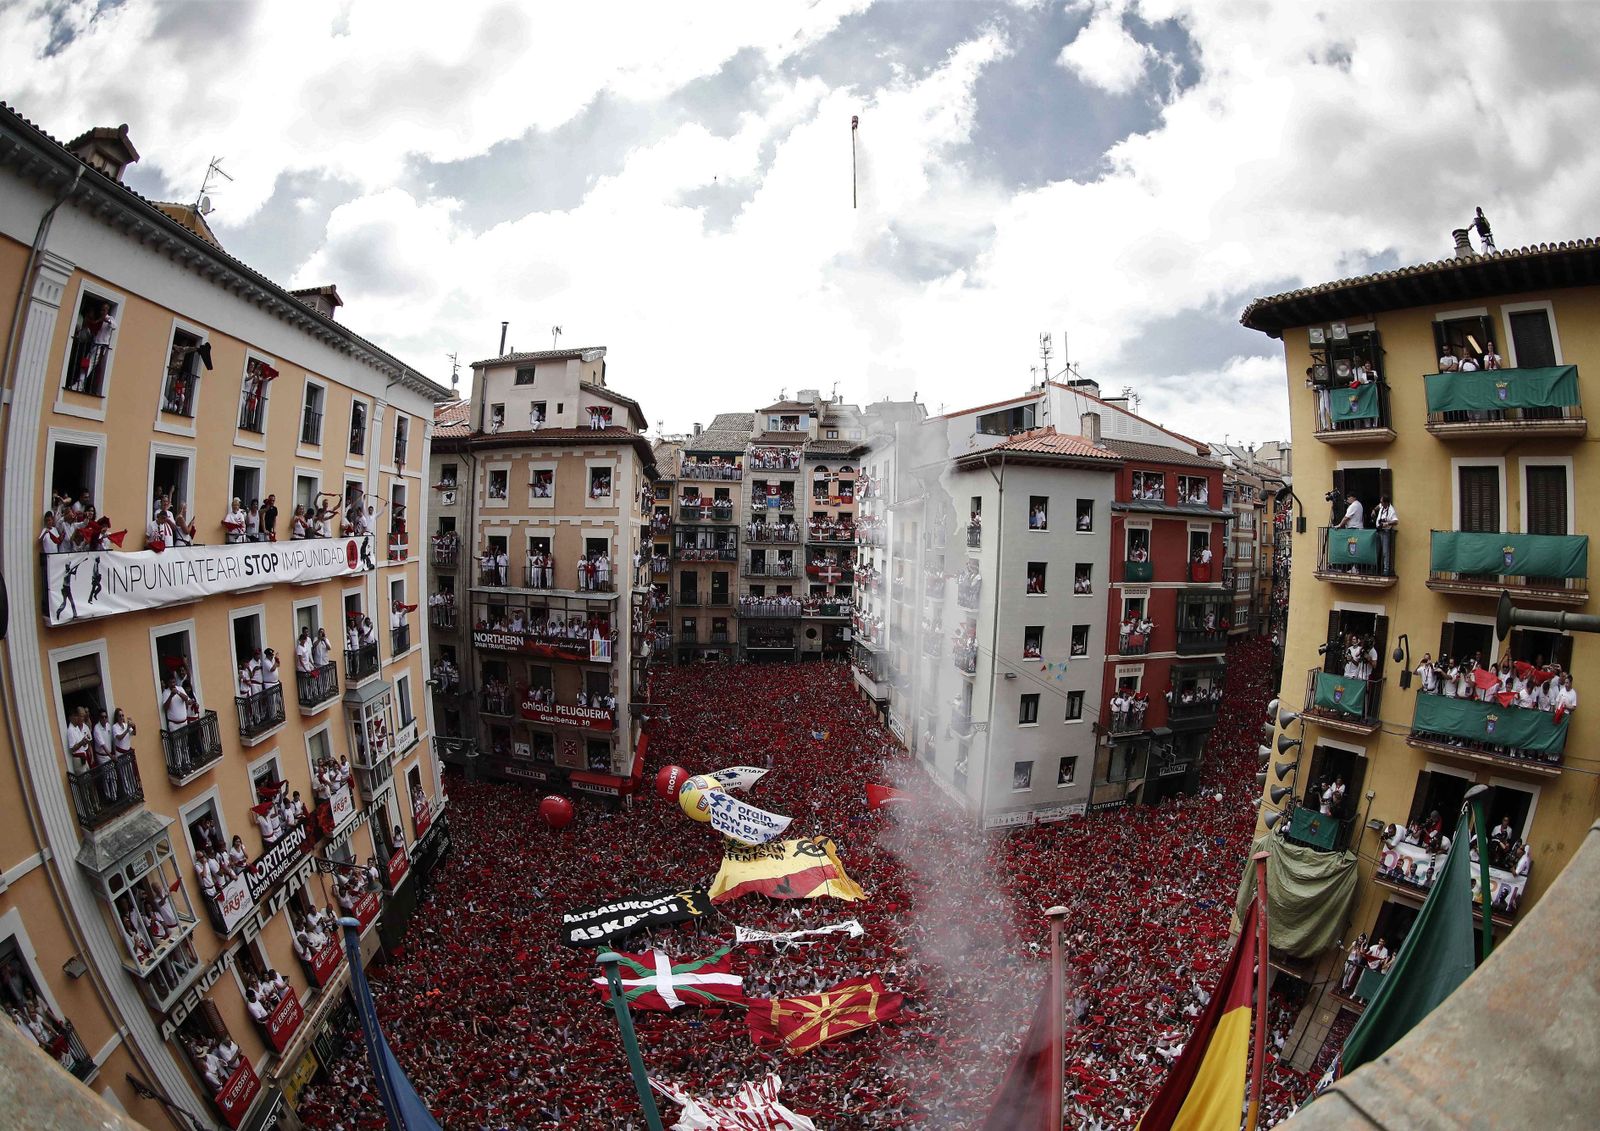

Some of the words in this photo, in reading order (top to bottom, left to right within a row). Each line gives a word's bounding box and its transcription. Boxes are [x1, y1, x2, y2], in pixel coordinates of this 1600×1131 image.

[107, 555, 242, 595] INPUNITATEARI
[244, 553, 279, 576] STOP
[281, 547, 344, 571] IMPUNIDAD
[473, 631, 525, 647] NORTHERN
[556, 704, 611, 721] PELUQUERIA
[581, 719, 591, 727] 30
[667, 768, 680, 796] EROSKI
[737, 806, 772, 823] orain
[246, 828, 307, 890] NORTHERN
[252, 877, 271, 900] SPAIN
[563, 894, 678, 924] ALTSASUKOAK
[161, 951, 235, 1041] AGENCIA
[242, 856, 318, 945] ELIZARI
[277, 998, 295, 1023] EROSKI
[231, 1069, 250, 1098] EROSKI
